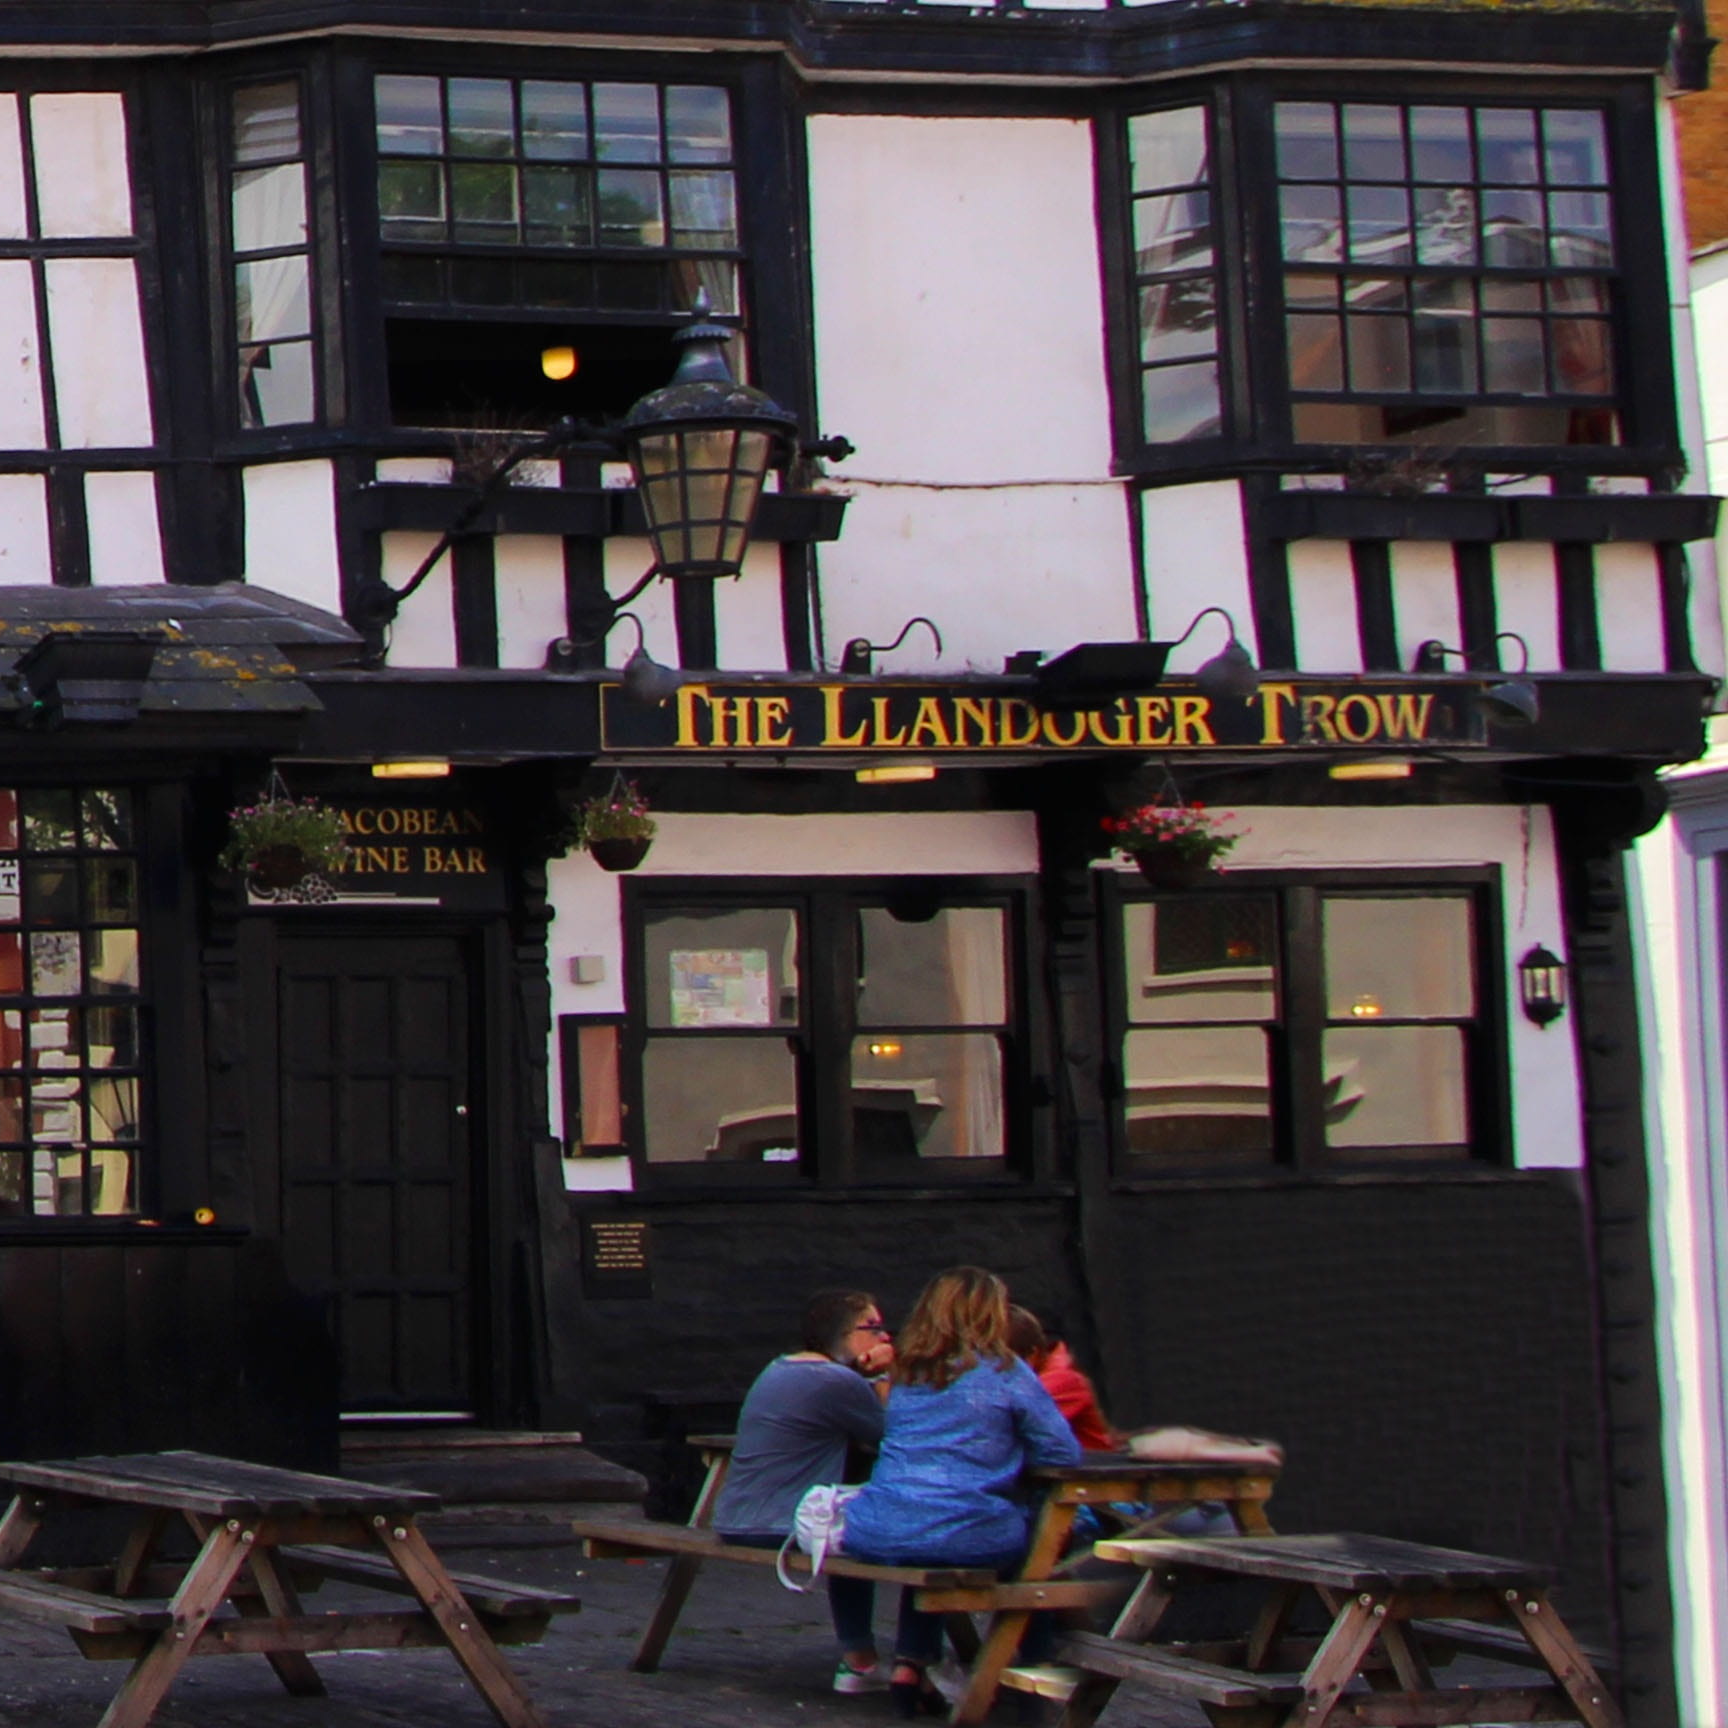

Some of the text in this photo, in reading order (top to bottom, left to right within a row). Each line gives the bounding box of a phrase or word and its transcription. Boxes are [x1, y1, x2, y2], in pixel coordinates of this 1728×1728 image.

[659, 682, 1435, 748] THE LLANDOGER TROW
[339, 807, 484, 835] ACOBEAN
[423, 846, 487, 873] BAR
